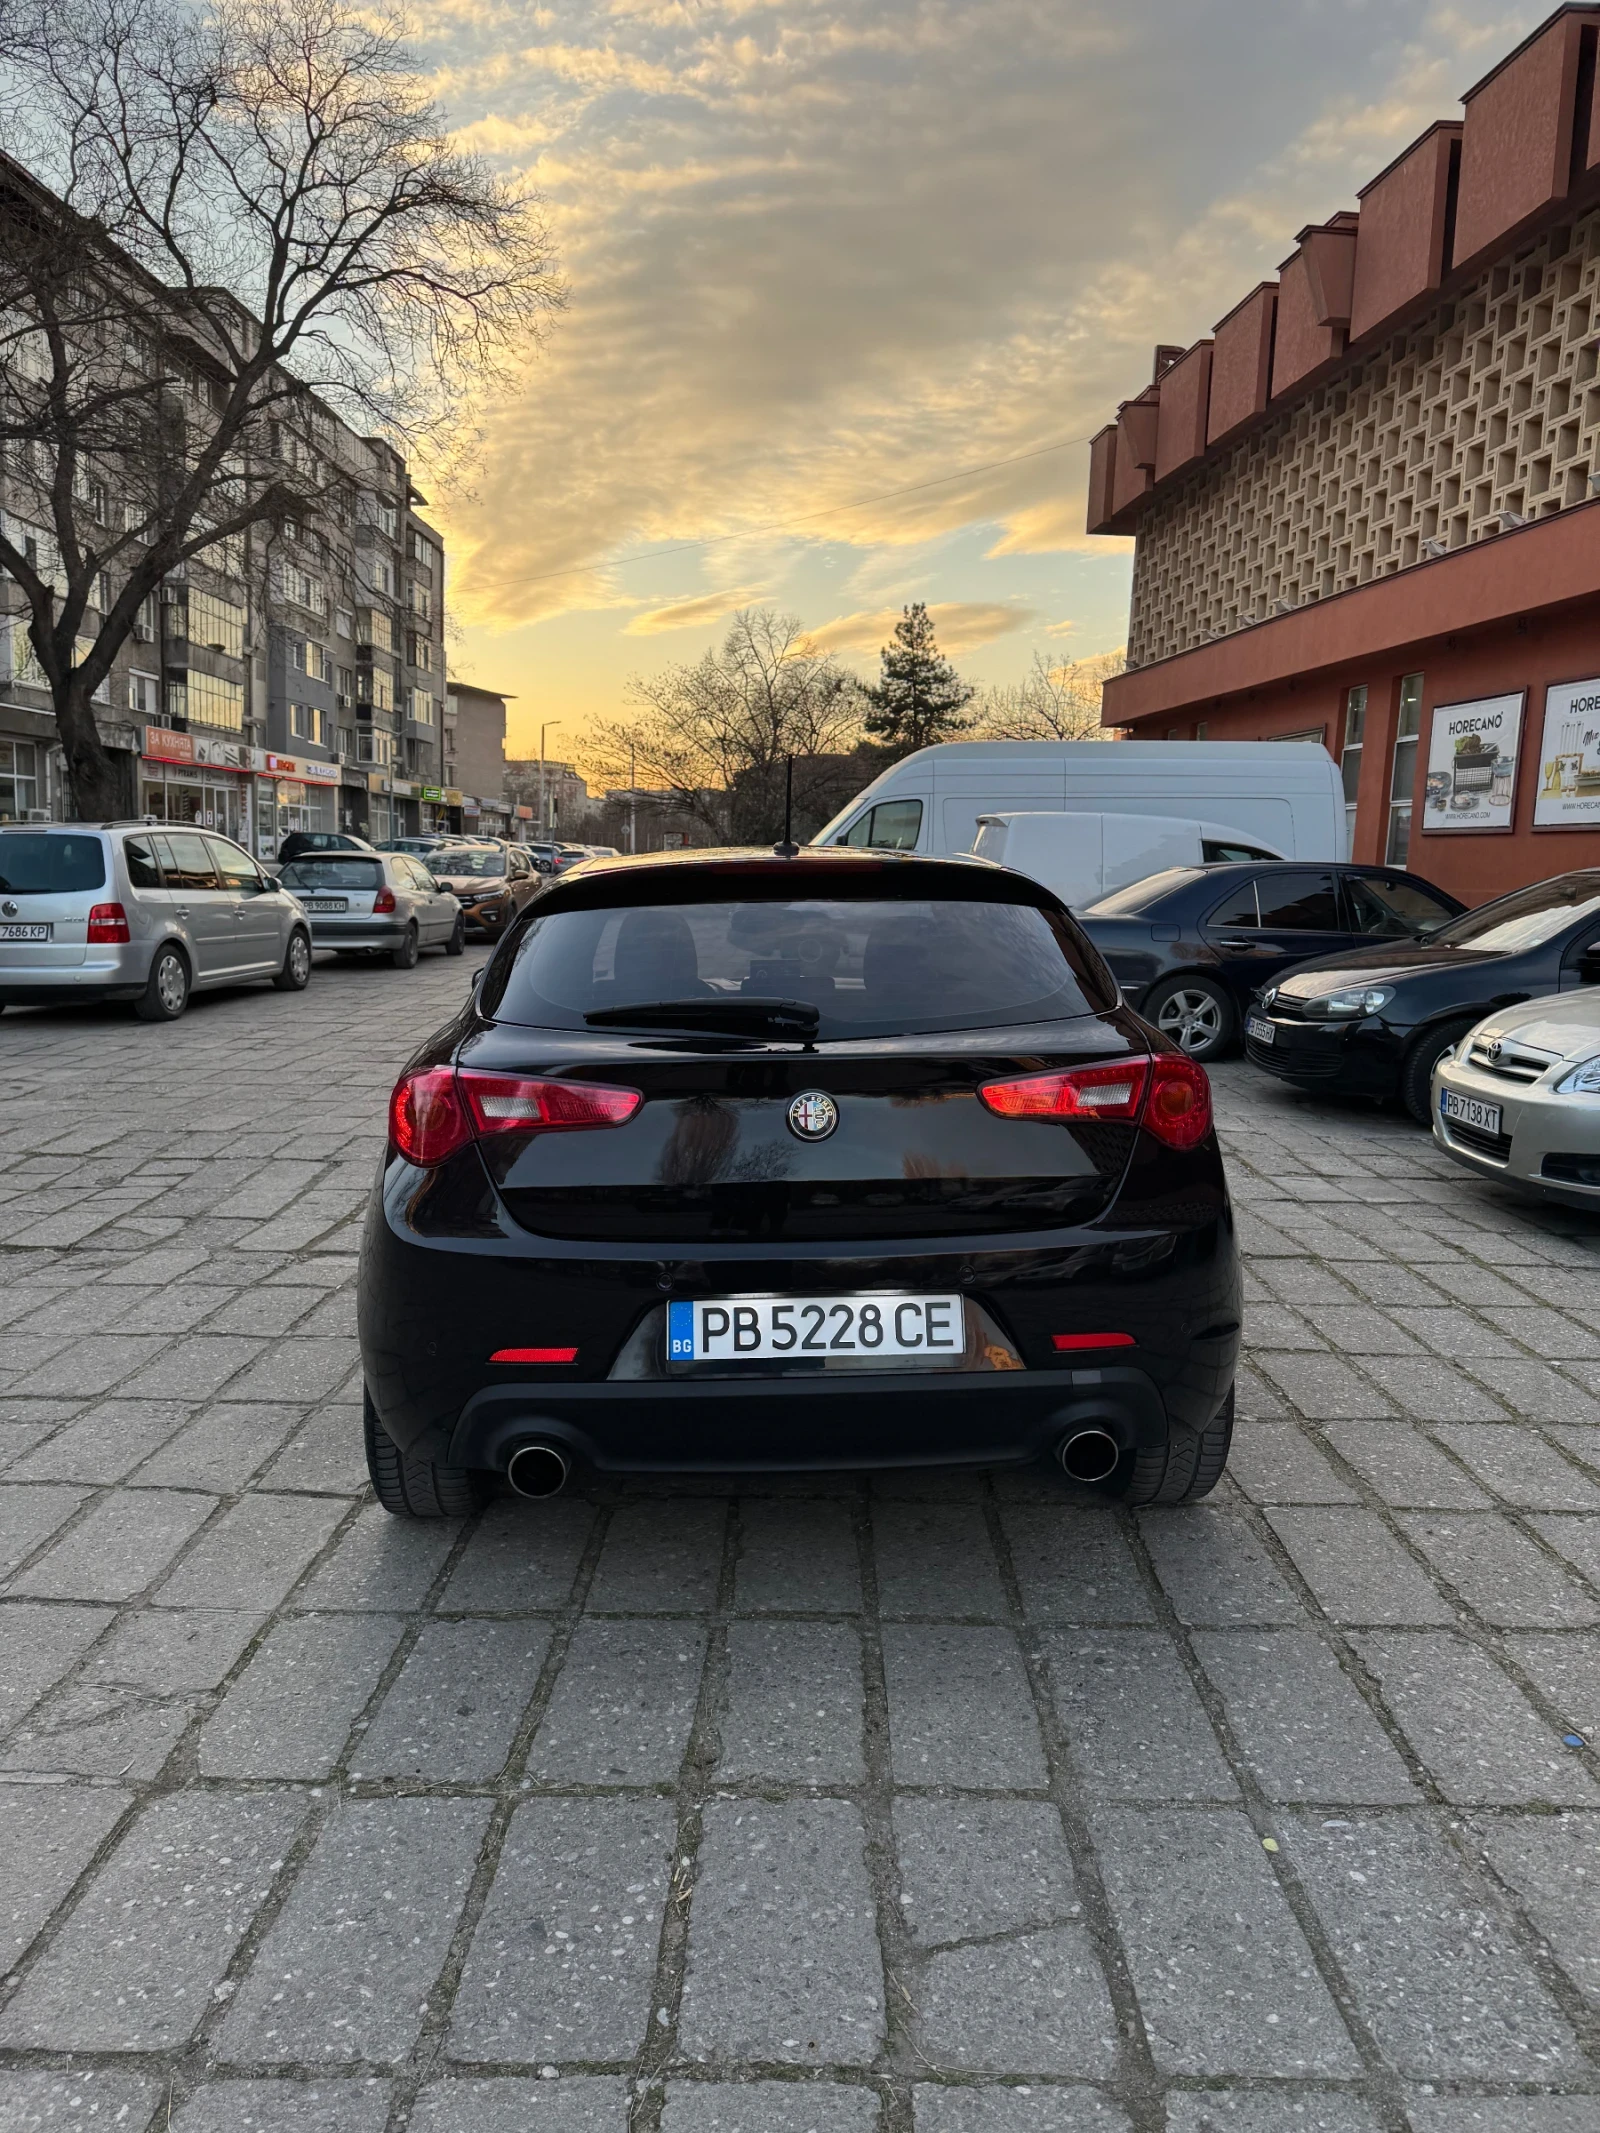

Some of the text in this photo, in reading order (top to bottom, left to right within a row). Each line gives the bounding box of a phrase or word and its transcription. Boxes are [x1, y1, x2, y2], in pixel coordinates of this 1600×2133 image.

[1449, 714, 1502, 735] HORECANO
[150, 731, 192, 750] ЗА КУХНЯТА
[1445, 811, 1490, 820] WWW.HORECANO.COM
[2, 926, 45, 937] 7686 KP
[1447, 1094, 1498, 1130] PB 7138 XT
[702, 1302, 953, 1352] PB 5228 CE
[672, 1339, 692, 1353] BG
